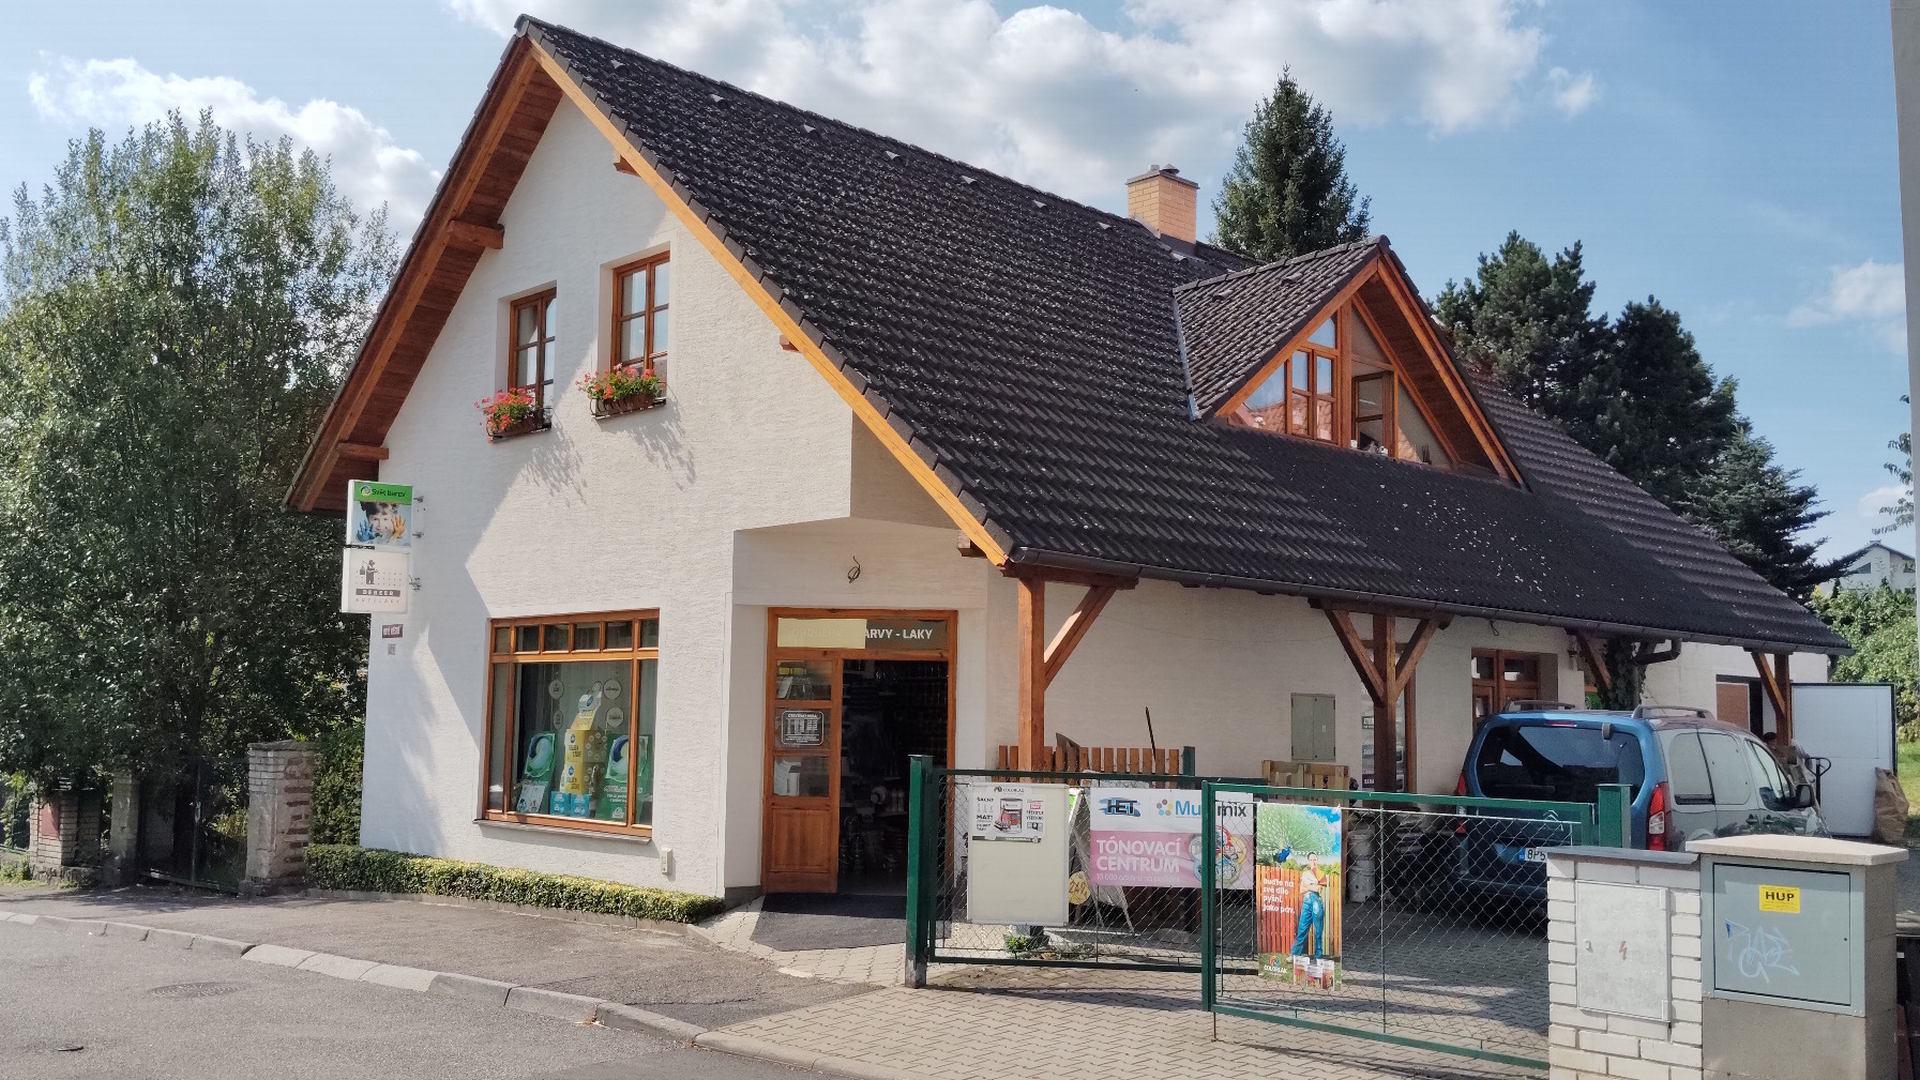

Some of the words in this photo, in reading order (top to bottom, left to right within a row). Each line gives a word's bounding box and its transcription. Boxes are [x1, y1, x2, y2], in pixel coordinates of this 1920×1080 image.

[864, 628, 893, 640] ARVY
[902, 628, 933, 640] LAKY
[1106, 799, 1139, 814] HET
[1096, 835, 1181, 857] TÓNOVACÍ
[1527, 848, 1546, 861] 8P5
[1096, 855, 1180, 873] CENTRUM
[1765, 891, 1795, 902] HUP
